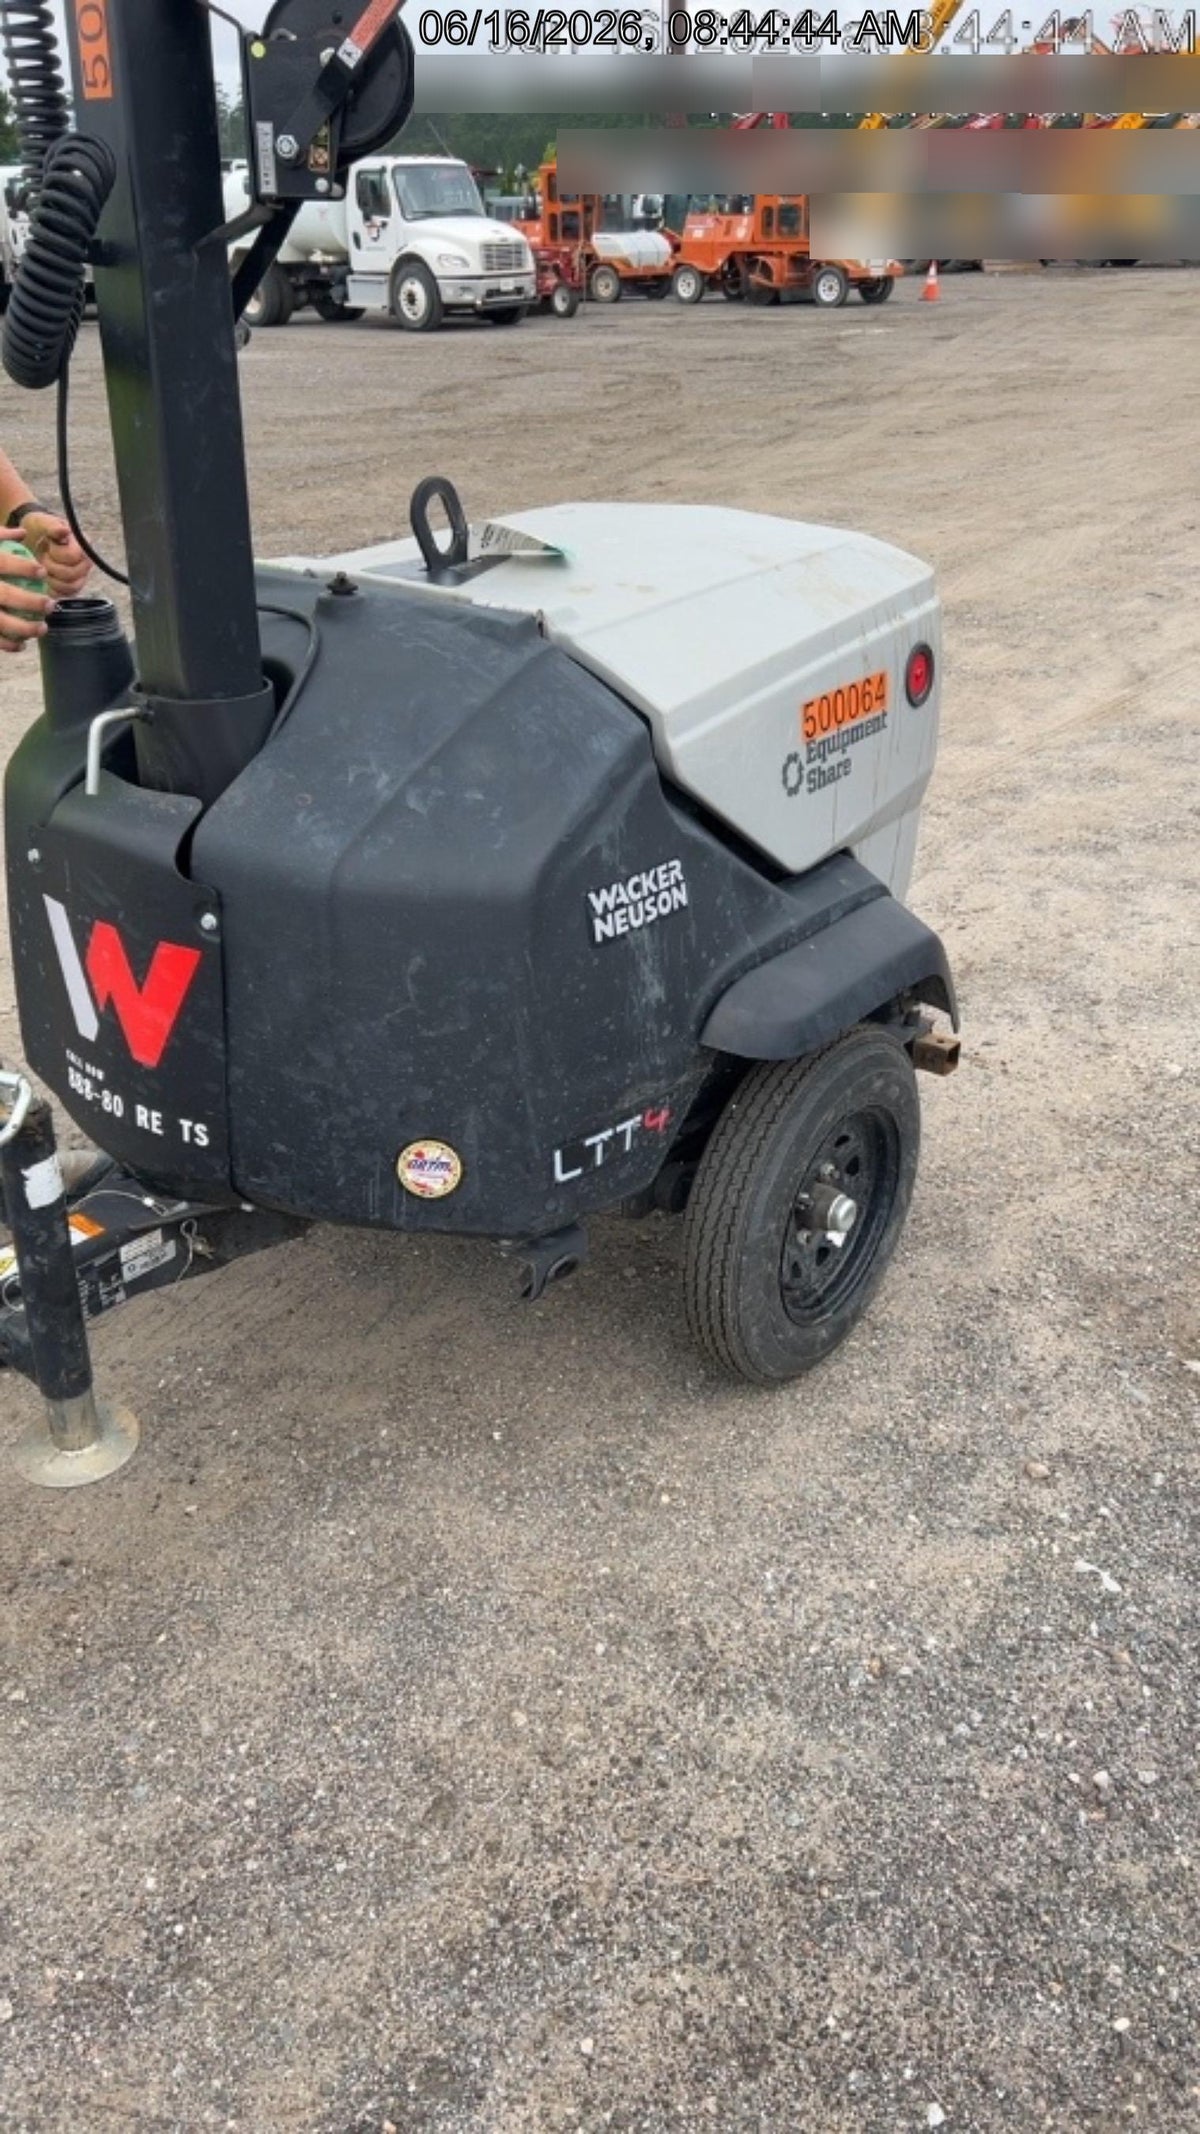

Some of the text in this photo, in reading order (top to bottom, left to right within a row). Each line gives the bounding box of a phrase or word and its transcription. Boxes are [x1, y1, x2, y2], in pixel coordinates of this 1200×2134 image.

[804, 673, 886, 739] 500064
[806, 708, 888, 764] Equipment
[806, 758, 852, 794] Share
[587, 859, 684, 916] WACKER
[593, 883, 688, 942] NEUSON
[178, 1119, 209, 1147] TS
